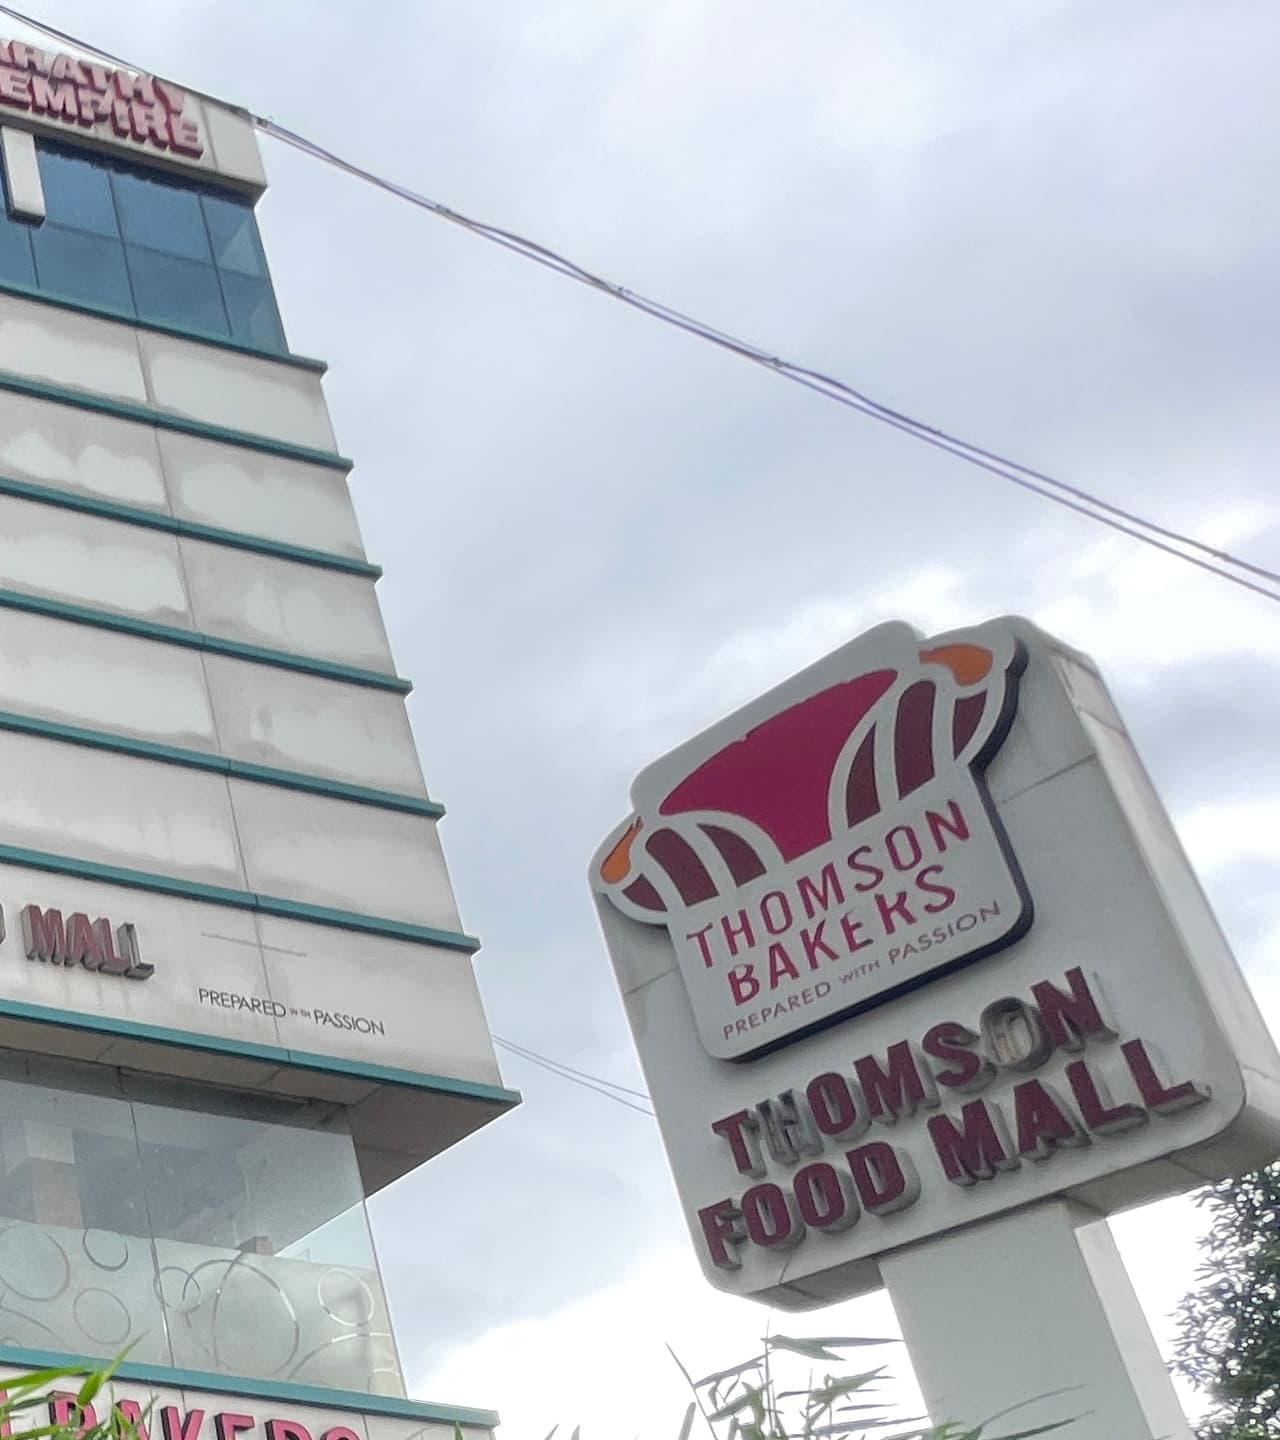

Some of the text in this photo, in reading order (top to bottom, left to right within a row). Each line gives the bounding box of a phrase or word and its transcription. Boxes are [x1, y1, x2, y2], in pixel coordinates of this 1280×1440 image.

[21, 903, 155, 981] MALL
[686, 800, 970, 968] THOMSON
[727, 865, 956, 1006] BAKERS
[198, 987, 286, 1018] PREPARED
[313, 1009, 385, 1036] PASSION
[723, 901, 1001, 1040] PREPARED WITH PASSION
[712, 965, 1119, 1177] THOMSON
[697, 1039, 1213, 1271] FOOD MALL
